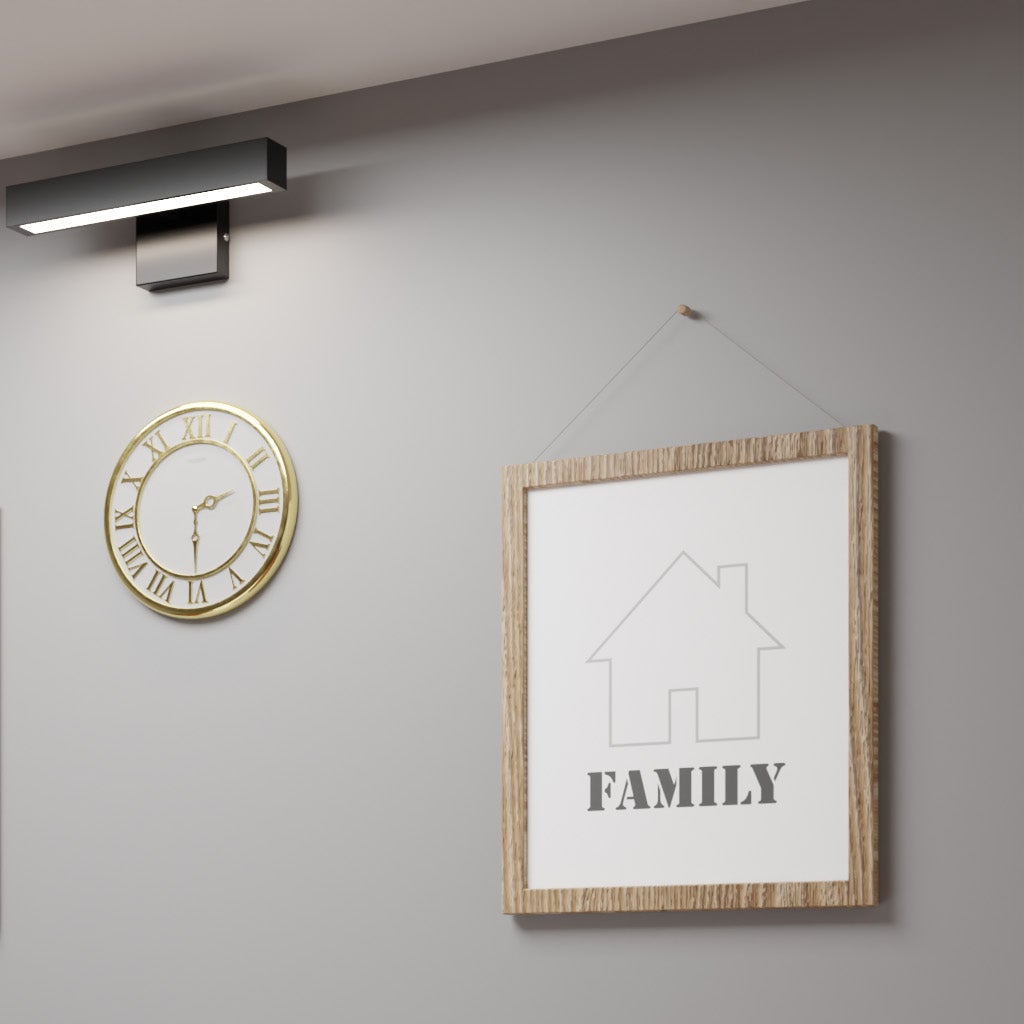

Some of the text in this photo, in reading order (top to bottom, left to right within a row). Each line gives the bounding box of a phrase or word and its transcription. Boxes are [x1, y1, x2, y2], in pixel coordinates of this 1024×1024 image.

[182, 413, 211, 440] XII
[142, 430, 171, 462] XI
[247, 447, 271, 470] II
[258, 488, 280, 514] III
[587, 762, 786, 811] FAMILY
